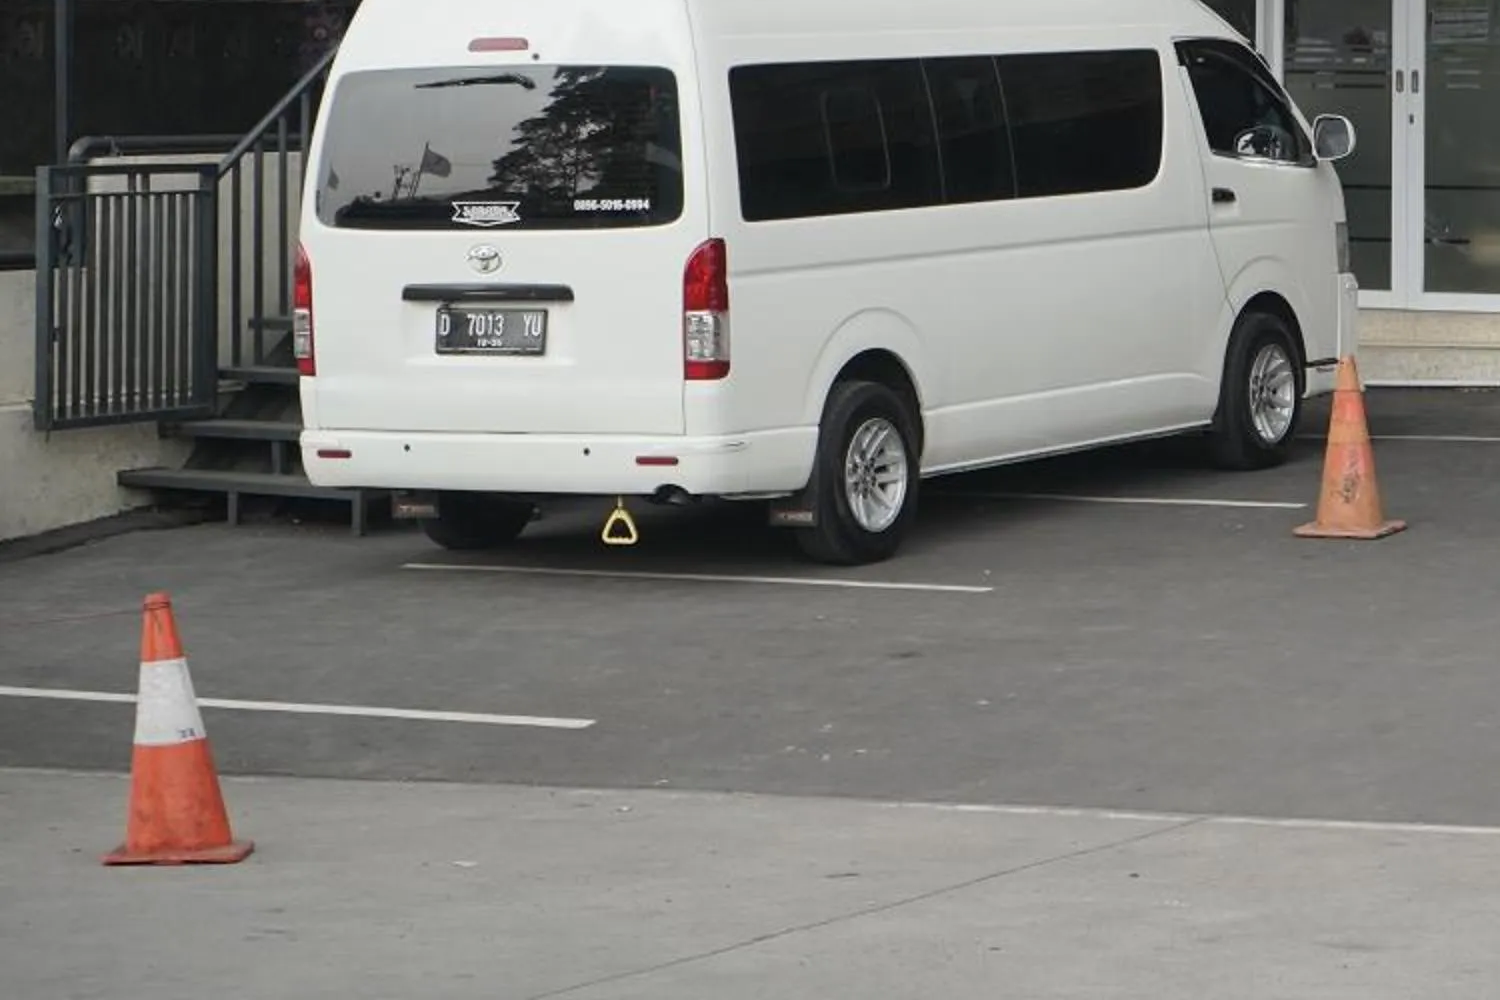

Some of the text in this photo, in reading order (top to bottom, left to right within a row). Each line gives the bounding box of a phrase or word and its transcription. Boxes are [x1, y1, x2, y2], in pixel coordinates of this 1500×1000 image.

[439, 312, 542, 337] D 7013 YU
